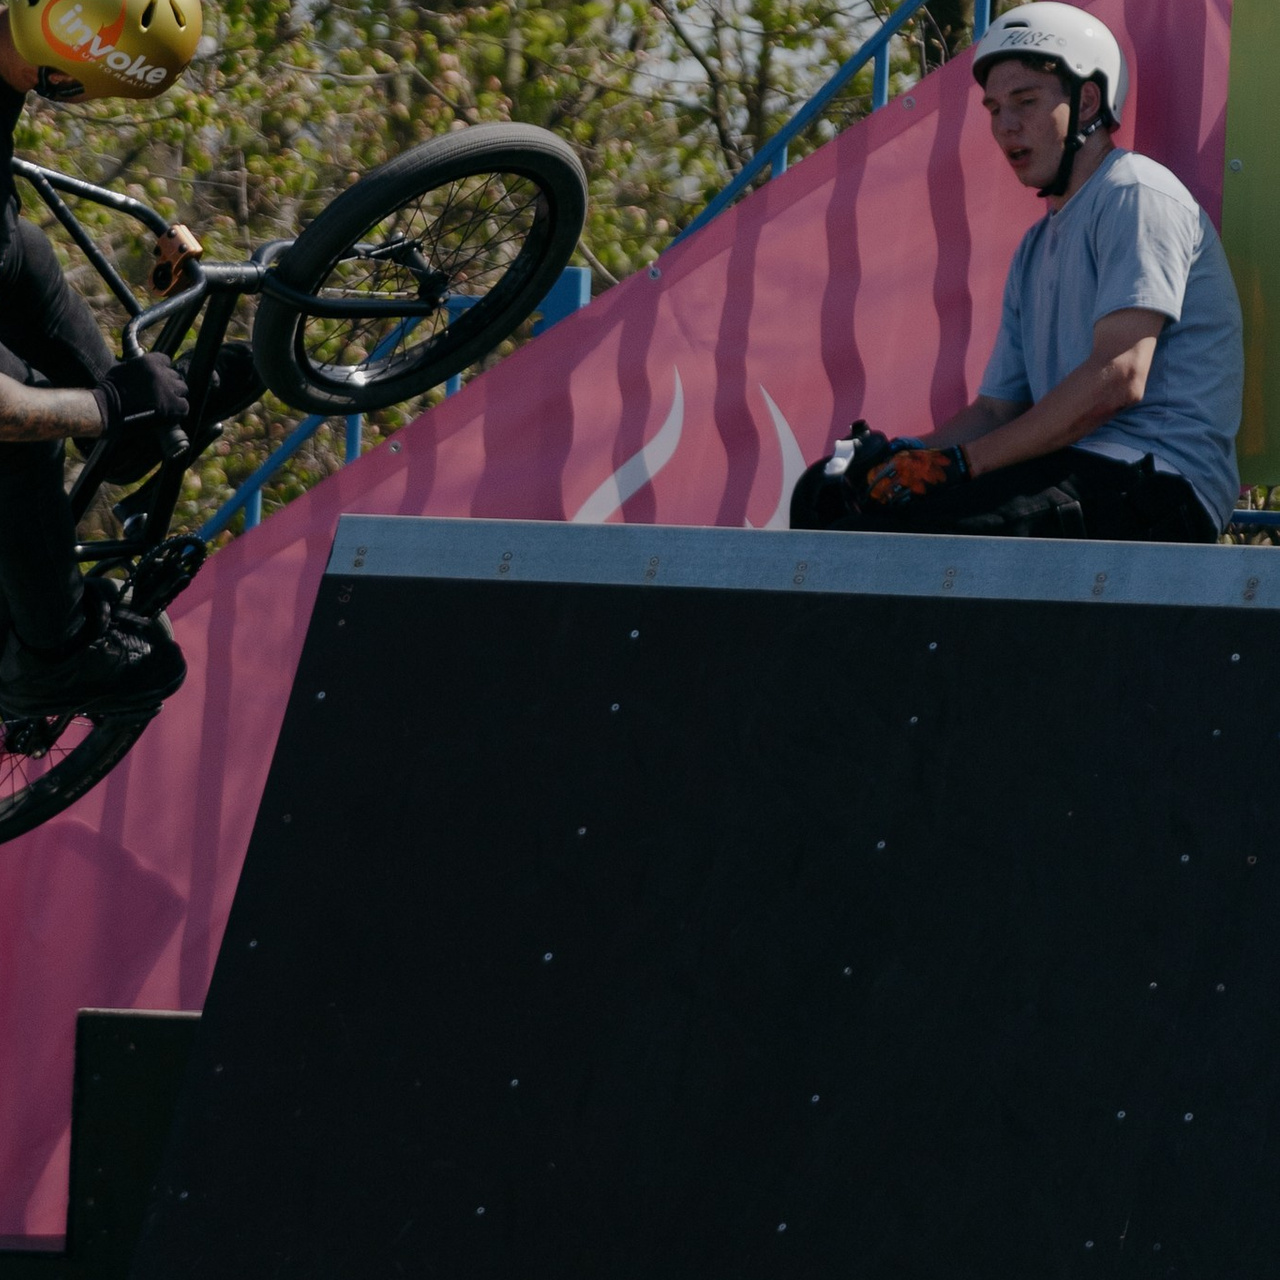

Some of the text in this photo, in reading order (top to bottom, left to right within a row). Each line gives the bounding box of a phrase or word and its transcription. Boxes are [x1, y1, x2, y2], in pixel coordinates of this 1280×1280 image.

[59, 3, 168, 84] invoke
[1000, 30, 1054, 47] FUSE
[99, 63, 112, 74] TO
